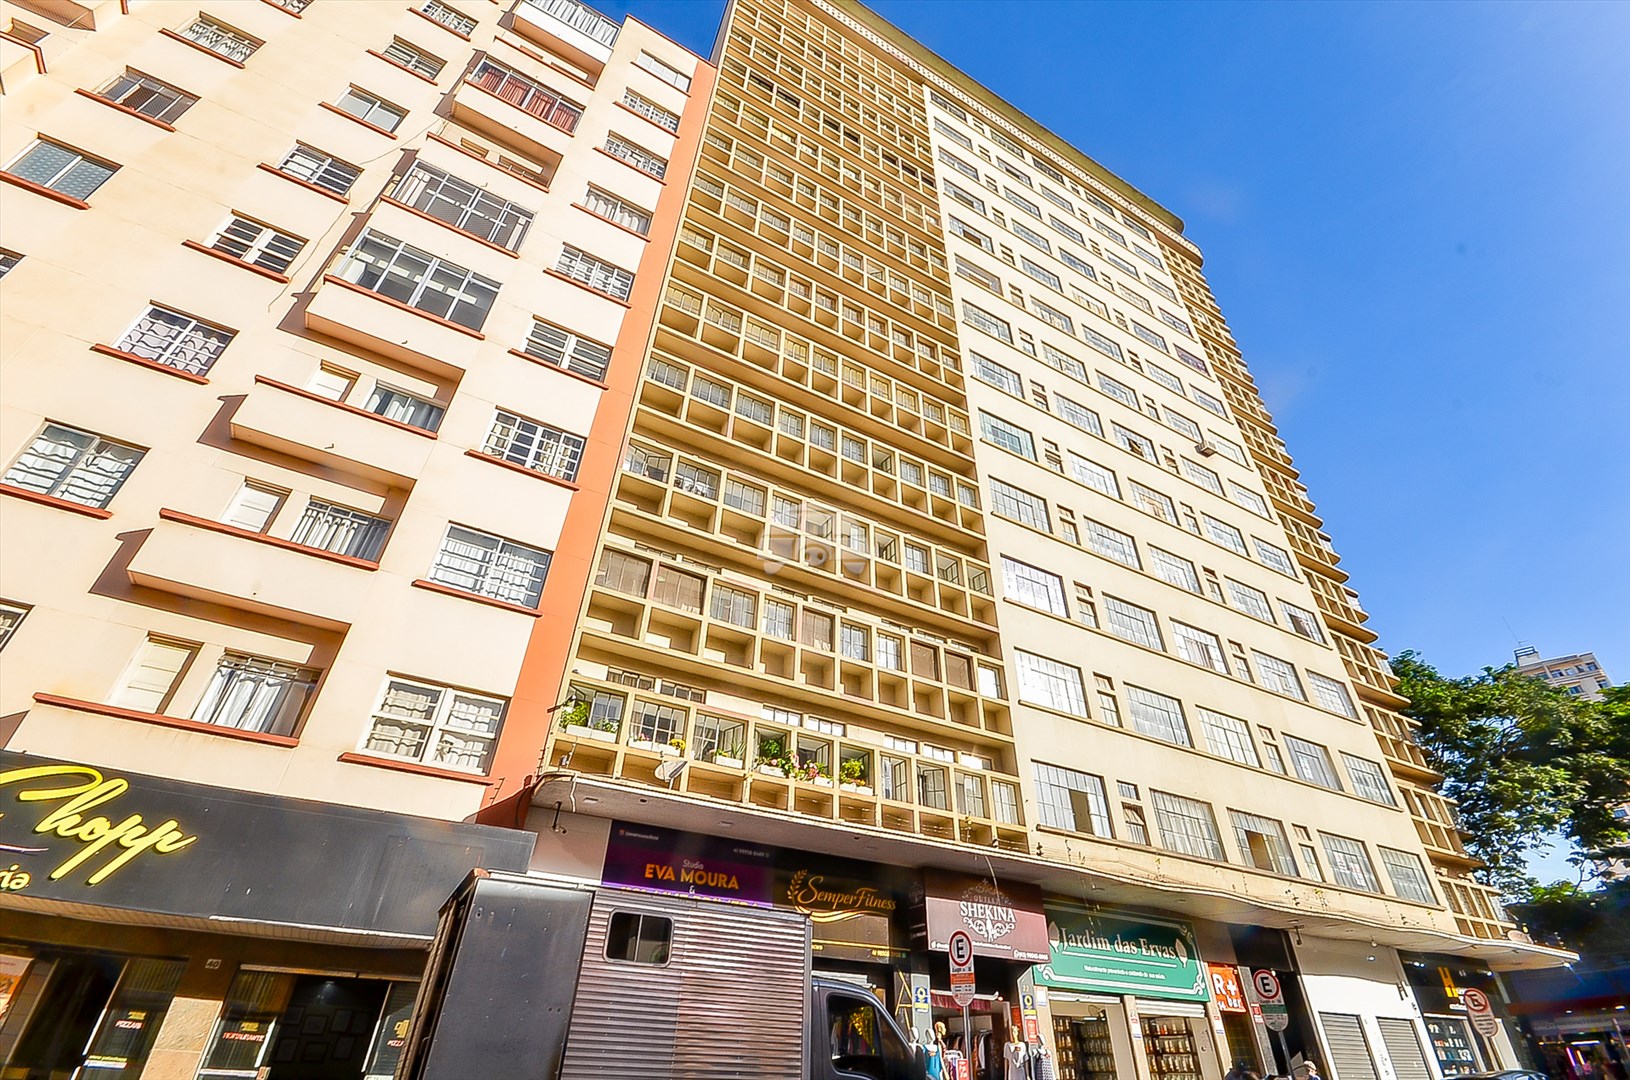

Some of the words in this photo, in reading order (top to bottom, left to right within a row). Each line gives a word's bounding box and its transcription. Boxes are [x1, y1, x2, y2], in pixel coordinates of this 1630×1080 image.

[682, 859, 704, 870] Studio
[644, 863, 675, 881] EVA
[680, 869, 739, 890] MOURA
[960, 901, 1016, 923] SHEKINA
[955, 938, 965, 959] E
[1060, 927, 1111, 952] Jardim
[1114, 934, 1138, 955] das
[1139, 937, 1176, 959] Ervas
[207, 960, 219, 968] 40
[1260, 976, 1272, 993] E
